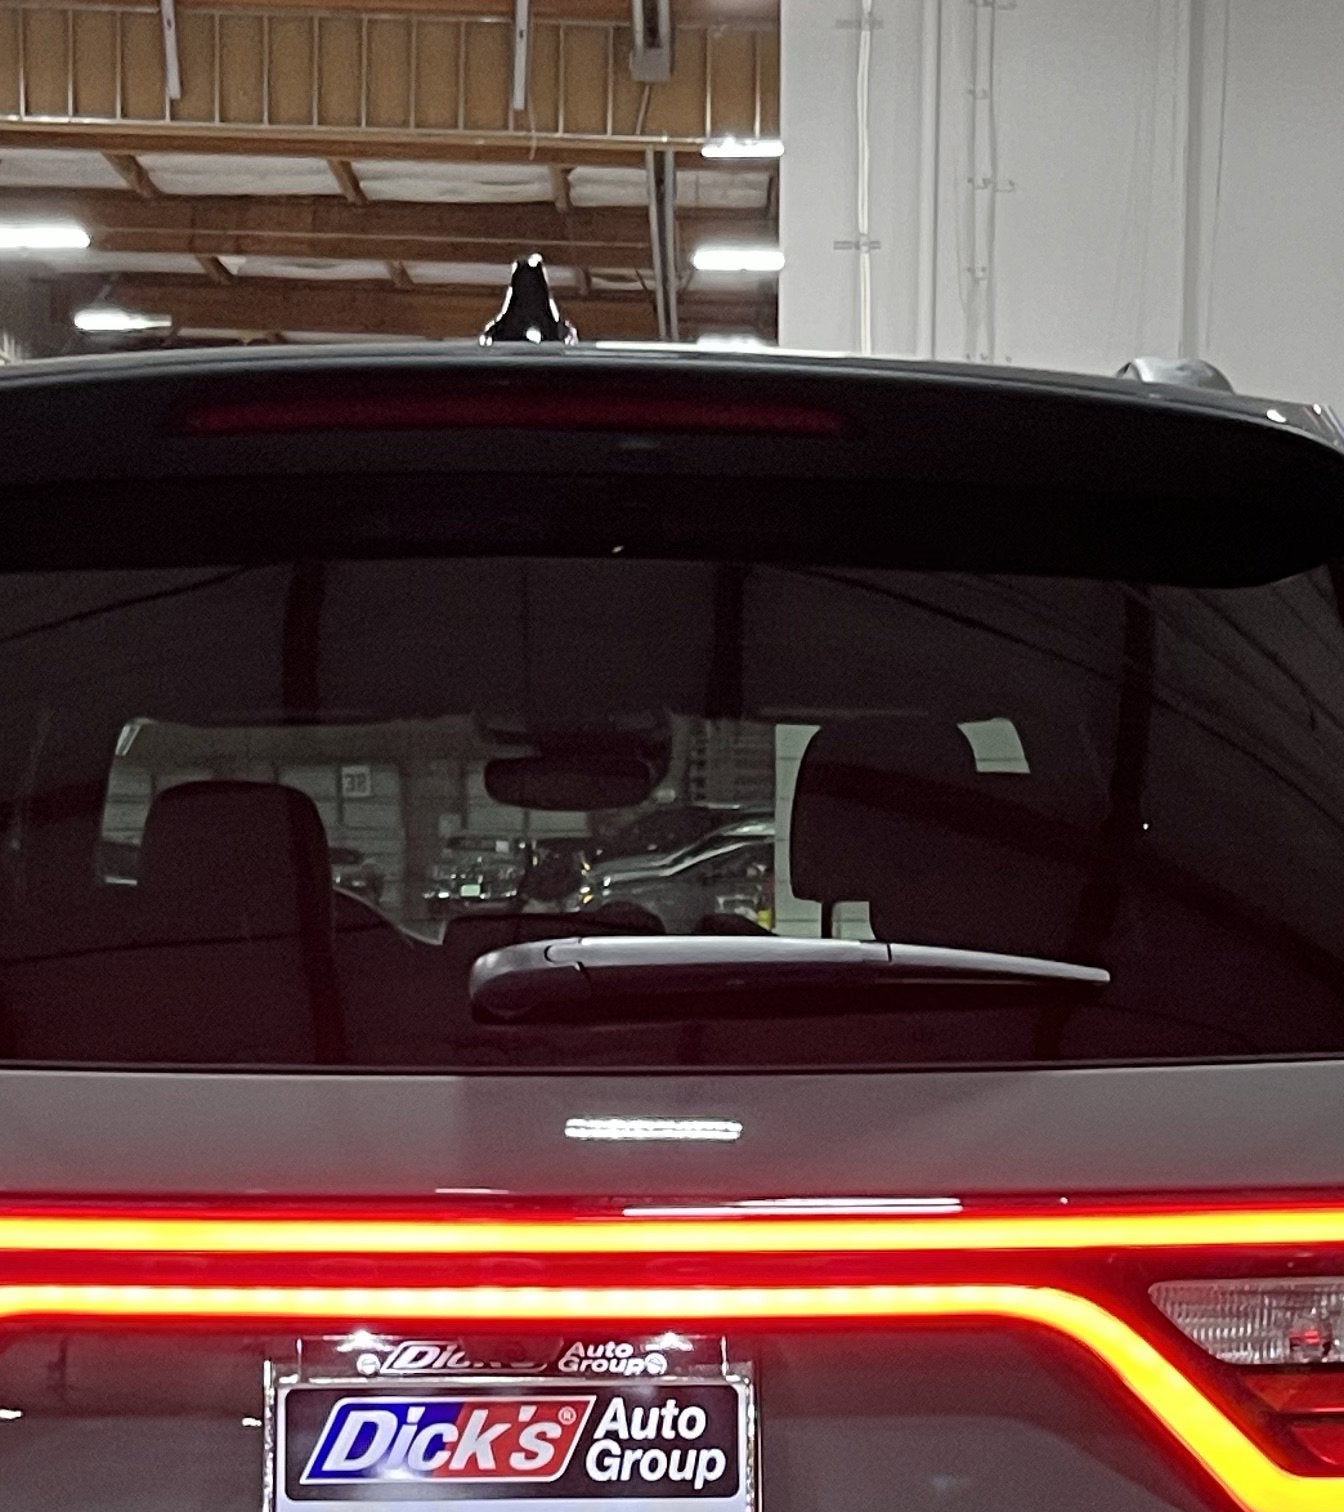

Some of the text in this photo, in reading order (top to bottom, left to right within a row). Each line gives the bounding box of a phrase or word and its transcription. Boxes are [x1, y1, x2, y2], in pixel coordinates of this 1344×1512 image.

[558, 1356, 646, 1376] Group
[567, 1341, 634, 1358] Auto
[322, 1405, 563, 1472] Dick's
[593, 1397, 707, 1441] Auto
[586, 1440, 727, 1489] Group
